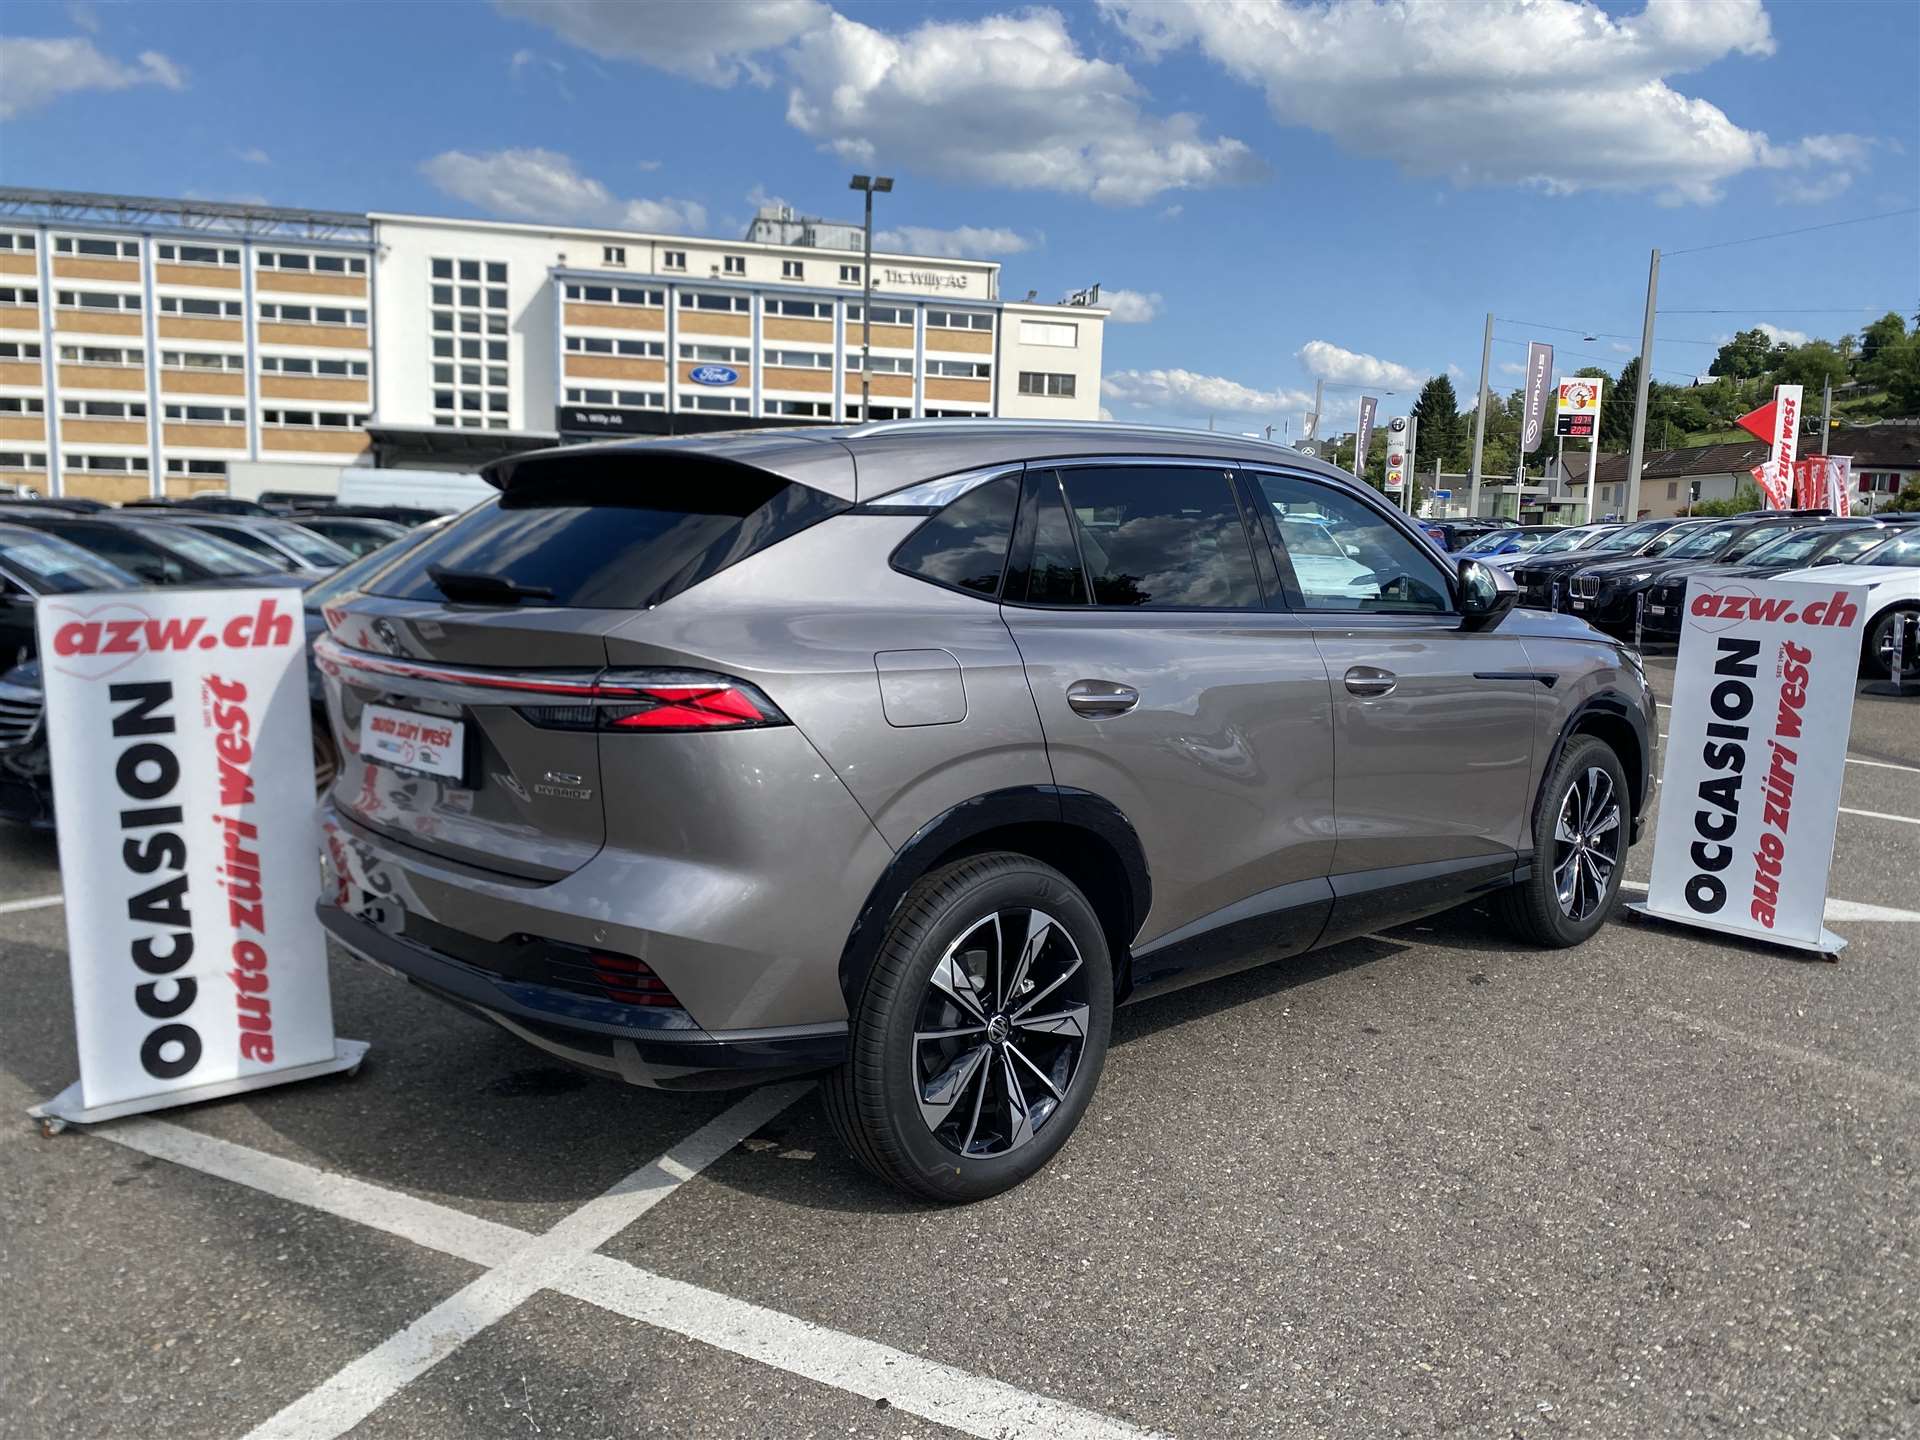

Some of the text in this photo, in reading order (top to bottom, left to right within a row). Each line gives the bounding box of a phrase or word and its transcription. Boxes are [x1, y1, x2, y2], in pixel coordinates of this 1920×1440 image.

[909, 270, 942, 290] Willy
[945, 274, 968, 289] AG
[698, 366, 730, 382] Ford
[1532, 353, 1545, 416] MAXUS
[589, 414, 609, 425] Willy
[1781, 397, 1797, 440] west
[1778, 441, 1793, 480] züri
[53, 598, 294, 657] azw.ch
[1690, 592, 1857, 627] azw.ch
[421, 728, 452, 748] west
[1684, 637, 1761, 915] OCCASION
[1750, 640, 1812, 929] auto züri west
[108, 681, 203, 1080] OCCASION
[203, 673, 275, 1064] auto züri west
